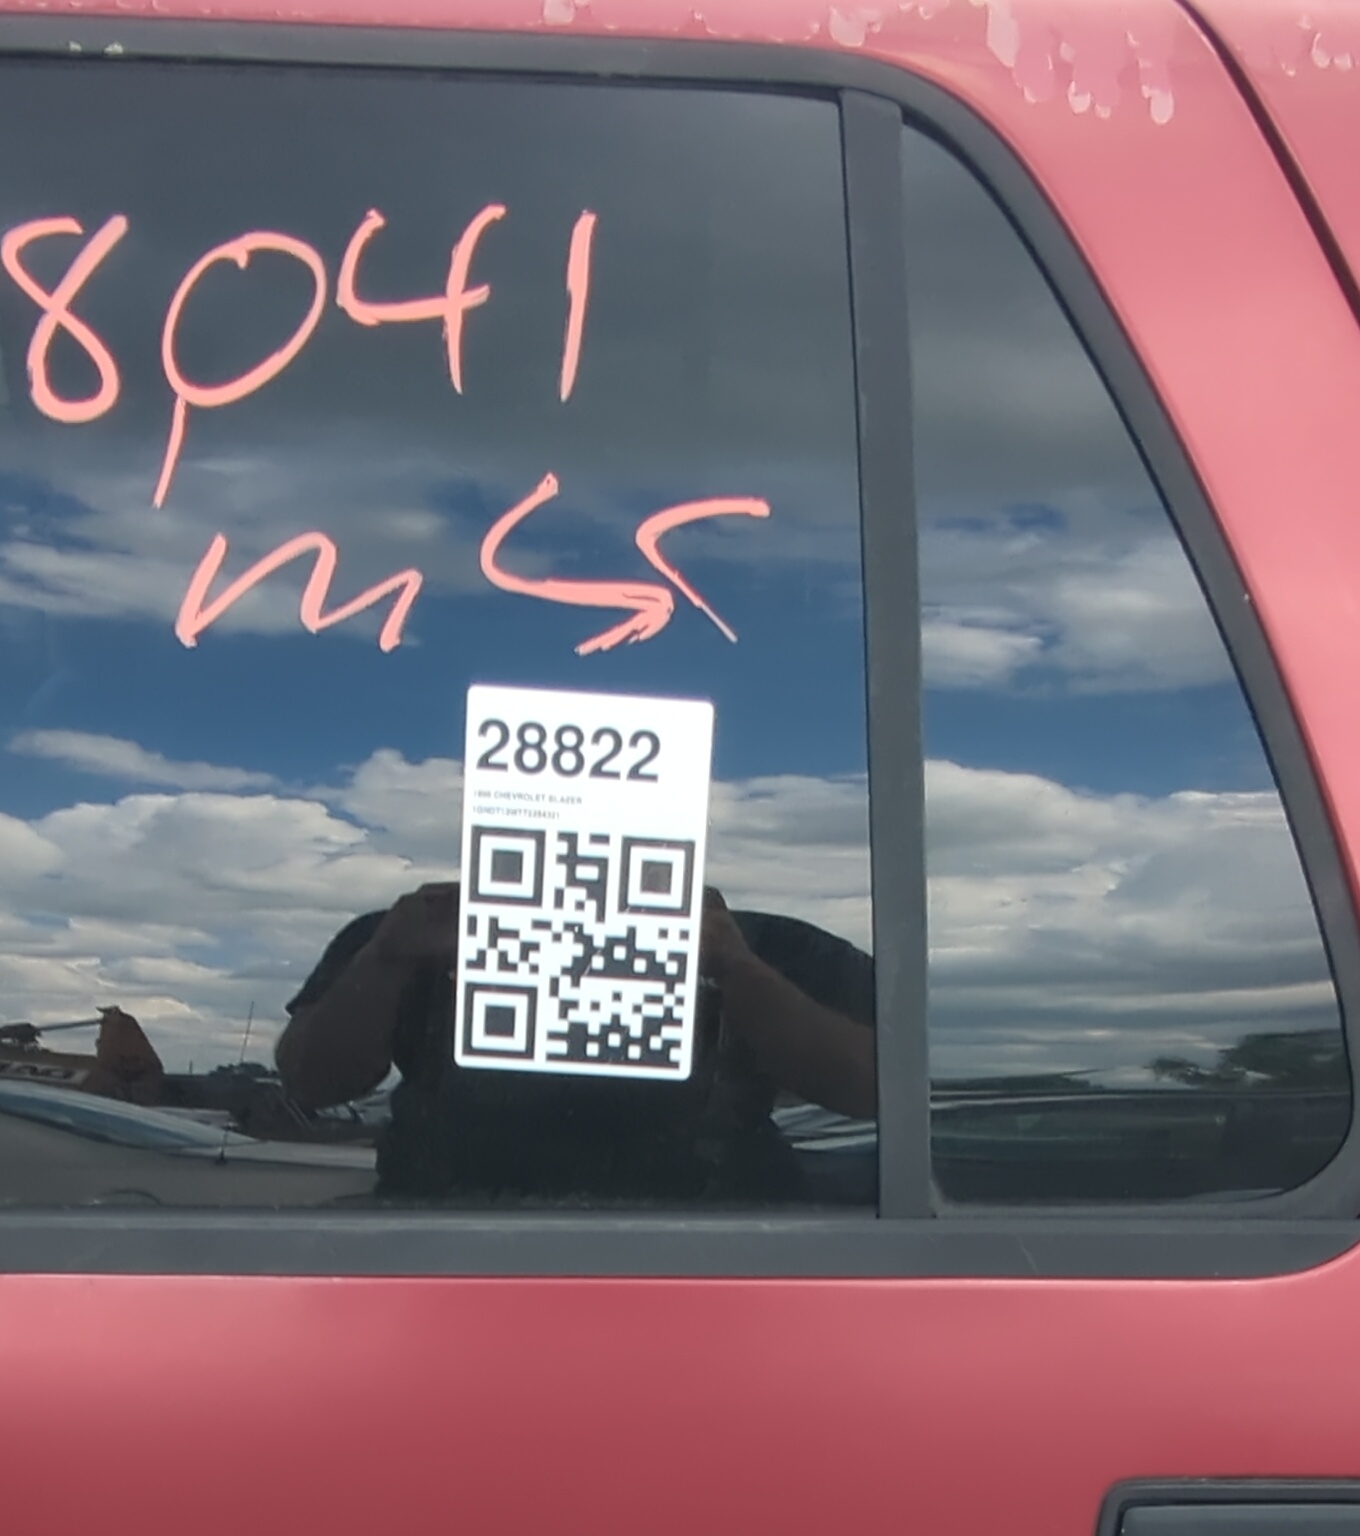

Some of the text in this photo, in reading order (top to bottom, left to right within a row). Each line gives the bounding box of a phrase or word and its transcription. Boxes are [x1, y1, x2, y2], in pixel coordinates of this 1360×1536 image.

[476, 717, 661, 783] 28822
[493, 790, 546, 803] CHEVROLET
[548, 793, 583, 806] BLAZER
